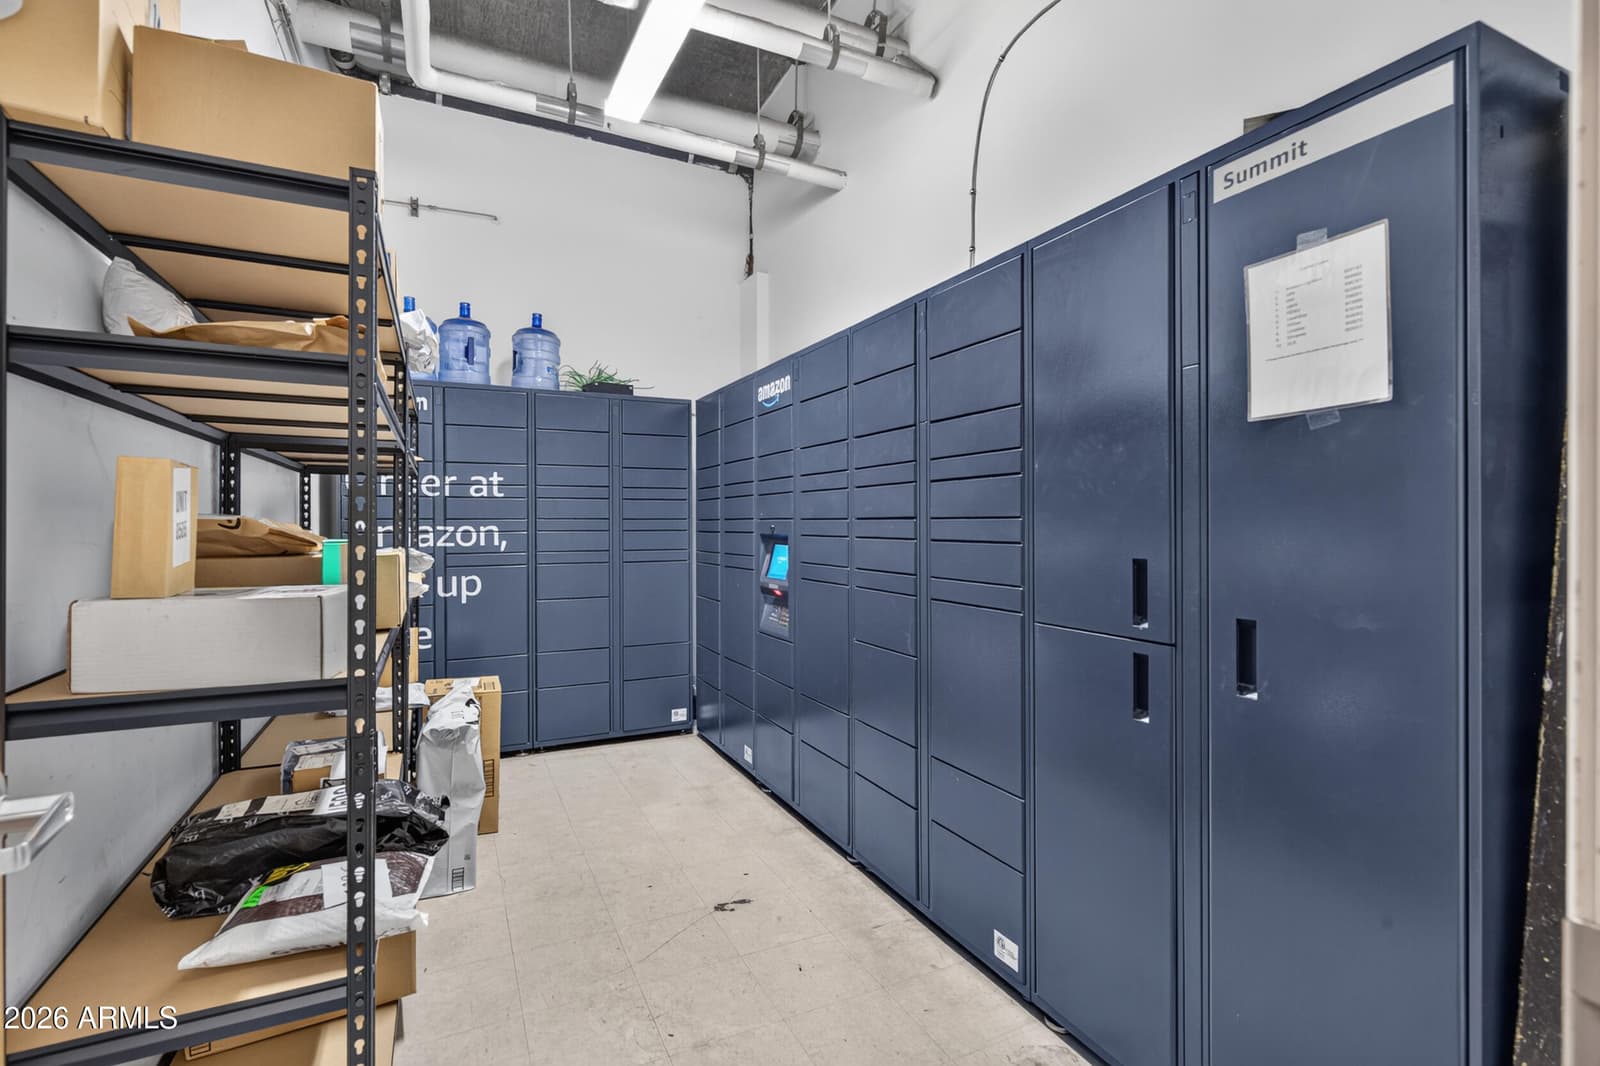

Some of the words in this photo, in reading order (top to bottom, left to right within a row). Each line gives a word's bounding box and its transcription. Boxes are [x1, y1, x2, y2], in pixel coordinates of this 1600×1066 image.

[1223, 139, 1308, 190] Summit
[757, 374, 791, 402] amazon
[345, 473, 457, 497] rer
[469, 471, 505, 497] at
[356, 523, 507, 552] azon,
[436, 574, 483, 604] up
